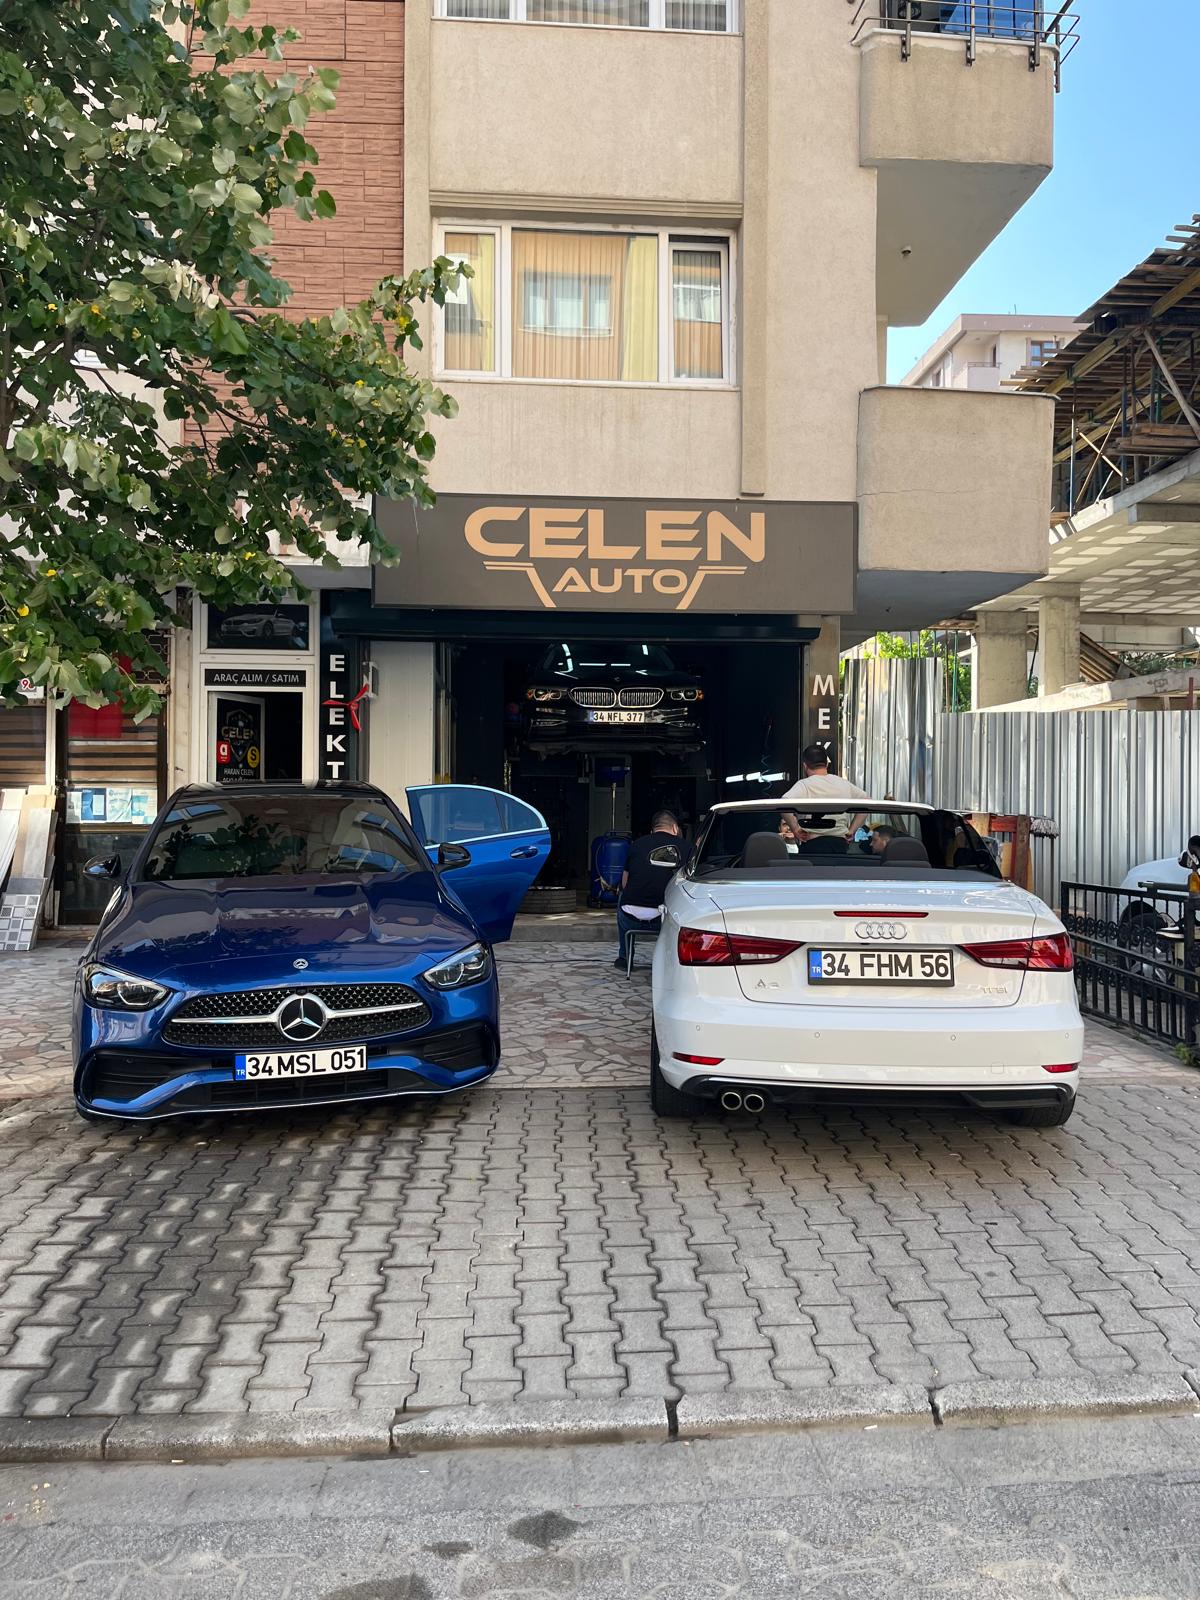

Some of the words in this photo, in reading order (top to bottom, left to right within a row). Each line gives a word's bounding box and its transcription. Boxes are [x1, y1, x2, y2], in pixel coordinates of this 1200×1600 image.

[464, 506, 766, 563] CELEN
[552, 567, 688, 594] AUTO
[213, 673, 239, 685] ARAÇ
[240, 673, 263, 682] ALIM
[271, 674, 300, 683] SATIM
[593, 712, 604, 721] 34
[607, 712, 624, 721] NFL
[627, 712, 643, 721] 377
[812, 966, 821, 974] TR
[823, 953, 850, 977] 34
[860, 953, 913, 977] FHM
[920, 954, 949, 978] 56
[247, 1056, 273, 1076] 34
[277, 1053, 327, 1076] MSL
[331, 1049, 364, 1070] 051
